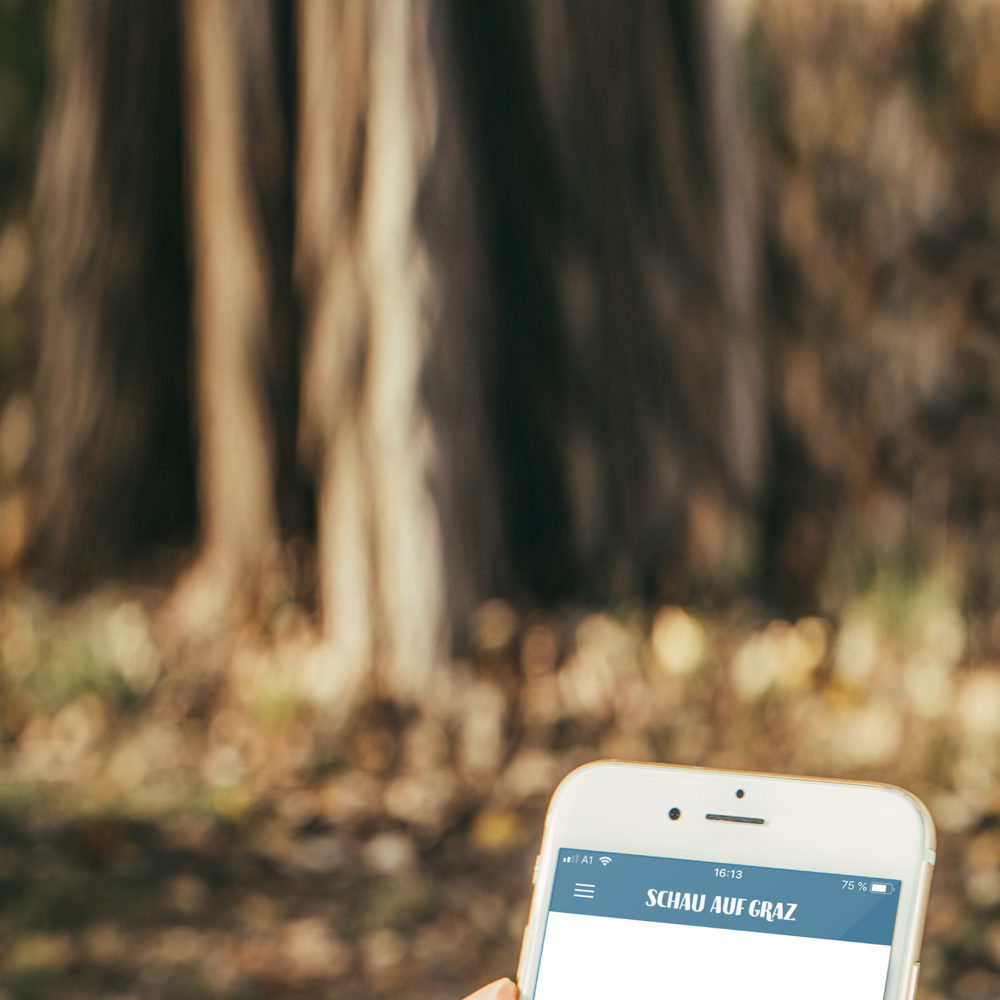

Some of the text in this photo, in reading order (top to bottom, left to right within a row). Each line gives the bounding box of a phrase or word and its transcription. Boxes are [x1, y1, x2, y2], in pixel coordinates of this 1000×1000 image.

[581, 855, 594, 865] A1
[713, 867, 744, 880] 16:13
[645, 888, 799, 923] SCHAU AUF GRAZ
